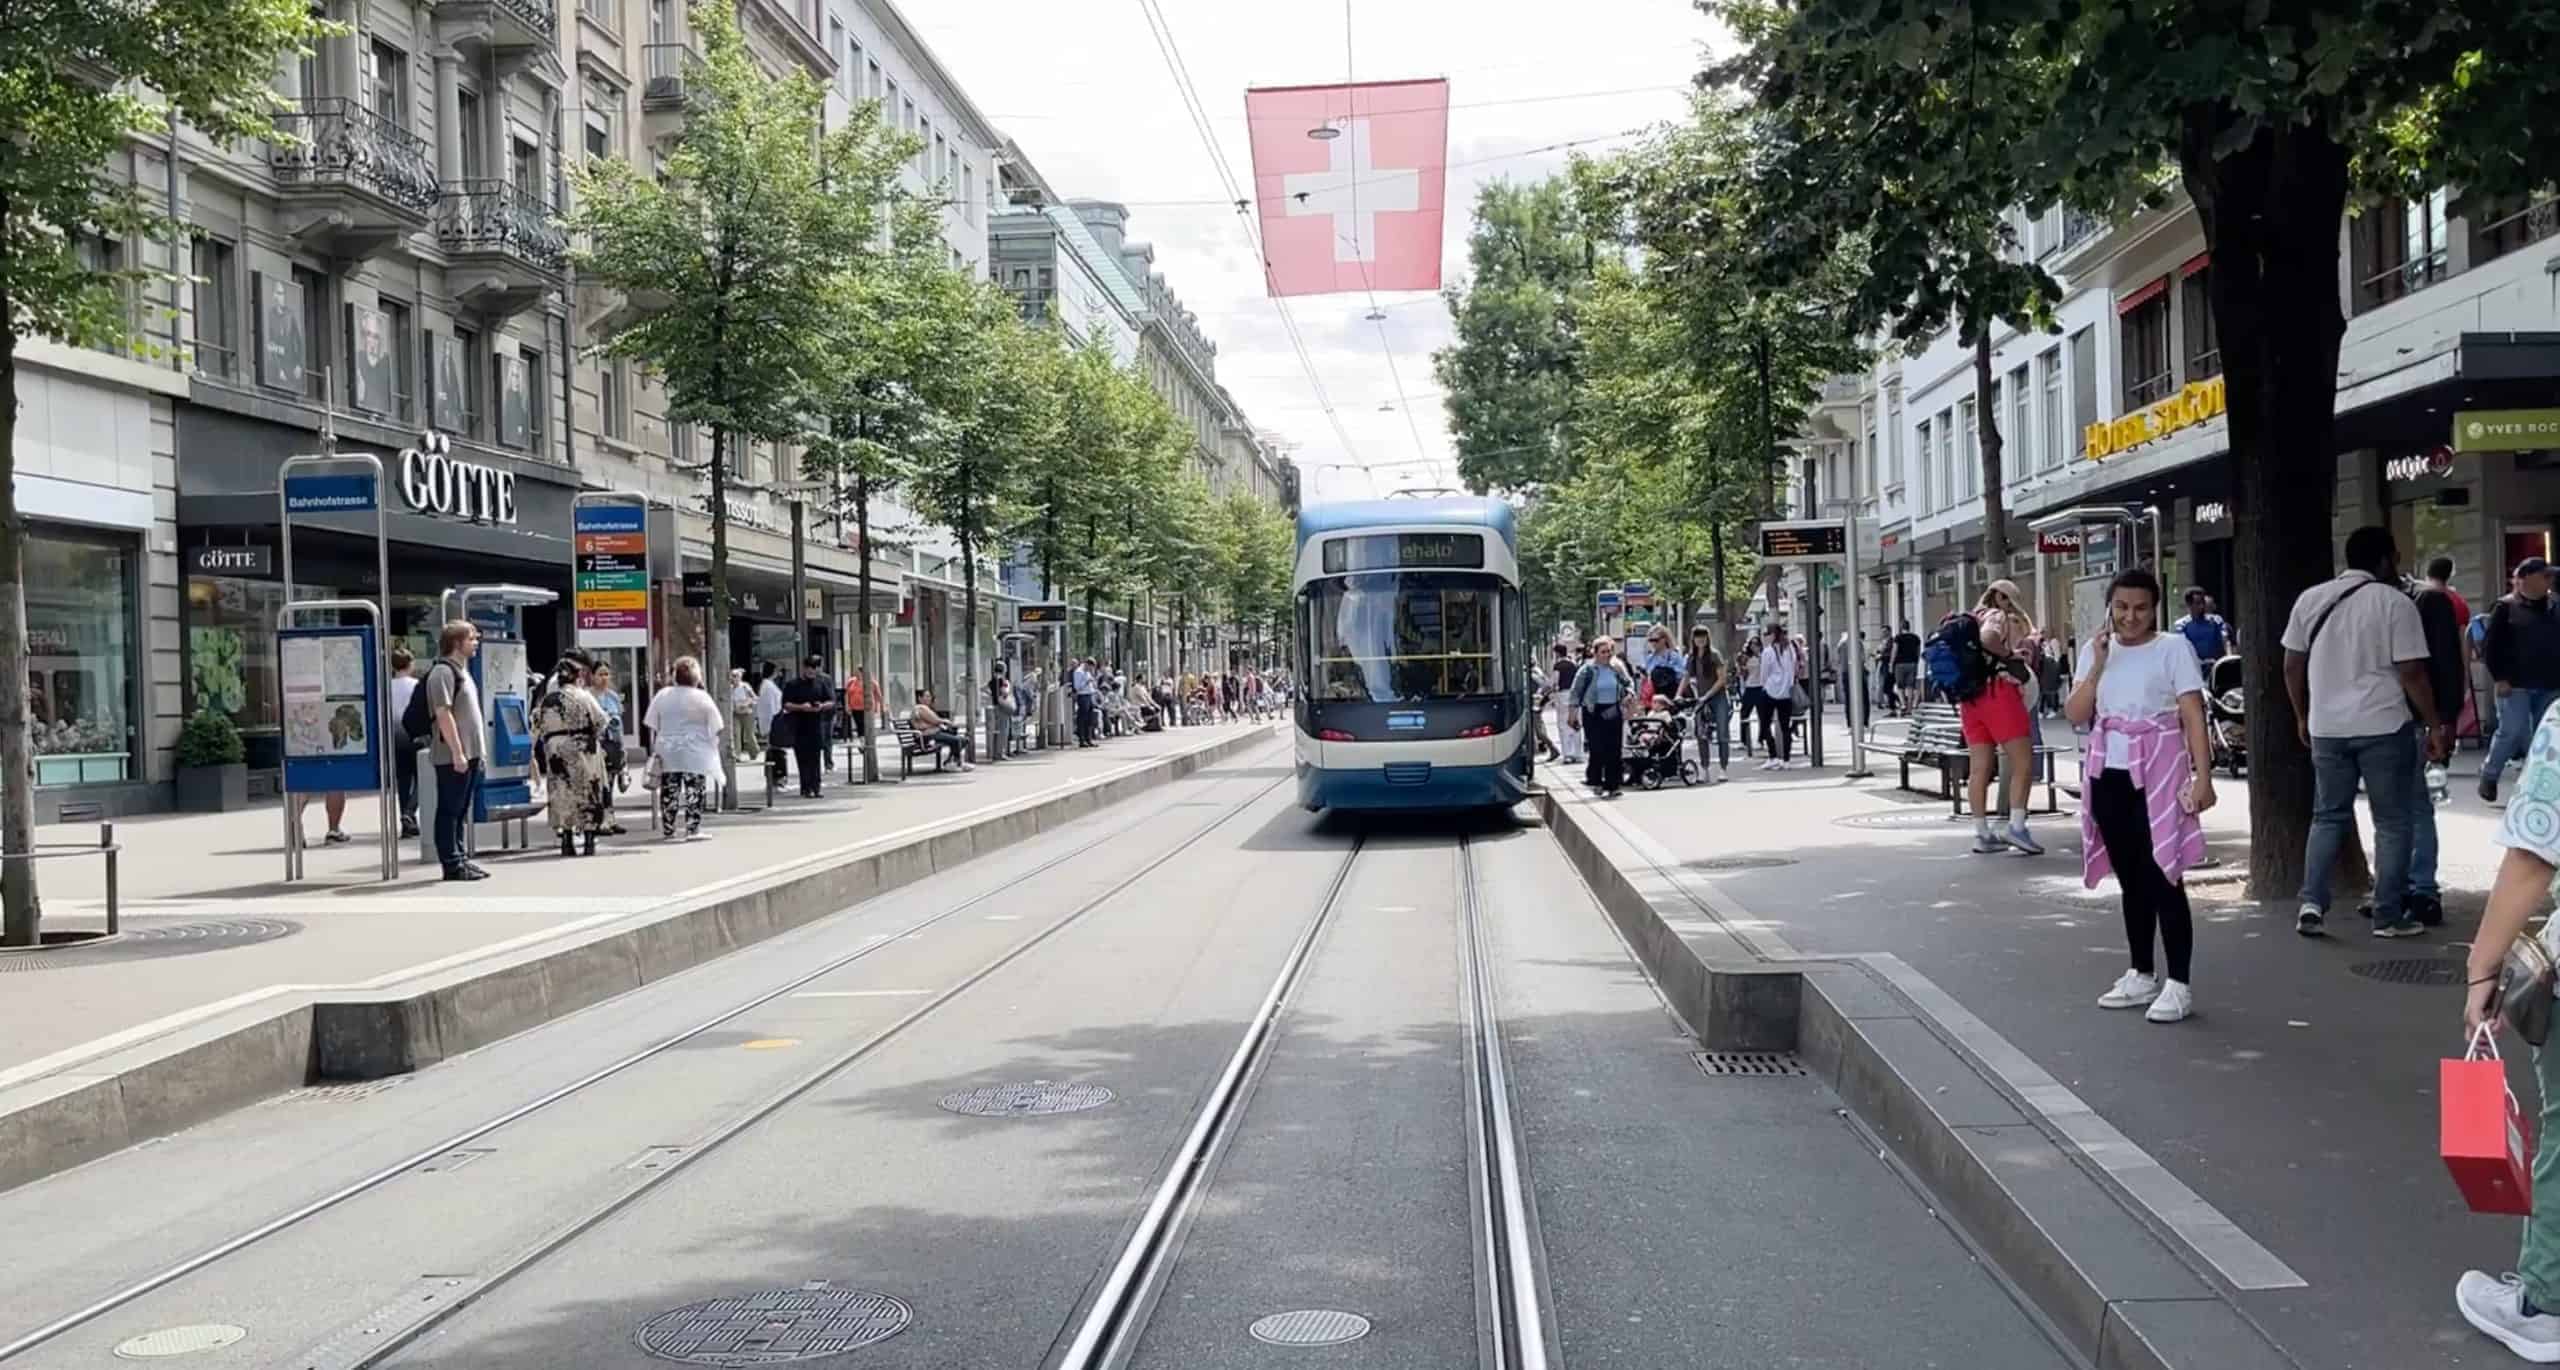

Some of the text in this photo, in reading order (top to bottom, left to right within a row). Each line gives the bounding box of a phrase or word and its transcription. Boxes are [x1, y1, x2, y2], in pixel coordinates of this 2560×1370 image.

[2487, 423, 2522, 434] YVES
[398, 430, 517, 524] GÖTTE
[288, 496, 368, 508] Bahnhofstrasse
[577, 522, 638, 532] Bahnhofstrasse
[585, 540, 594, 552] 6
[199, 549, 256, 568] GÖTTE
[585, 559, 594, 571] 7
[584, 579, 595, 590] 11
[584, 616, 595, 627] 17
